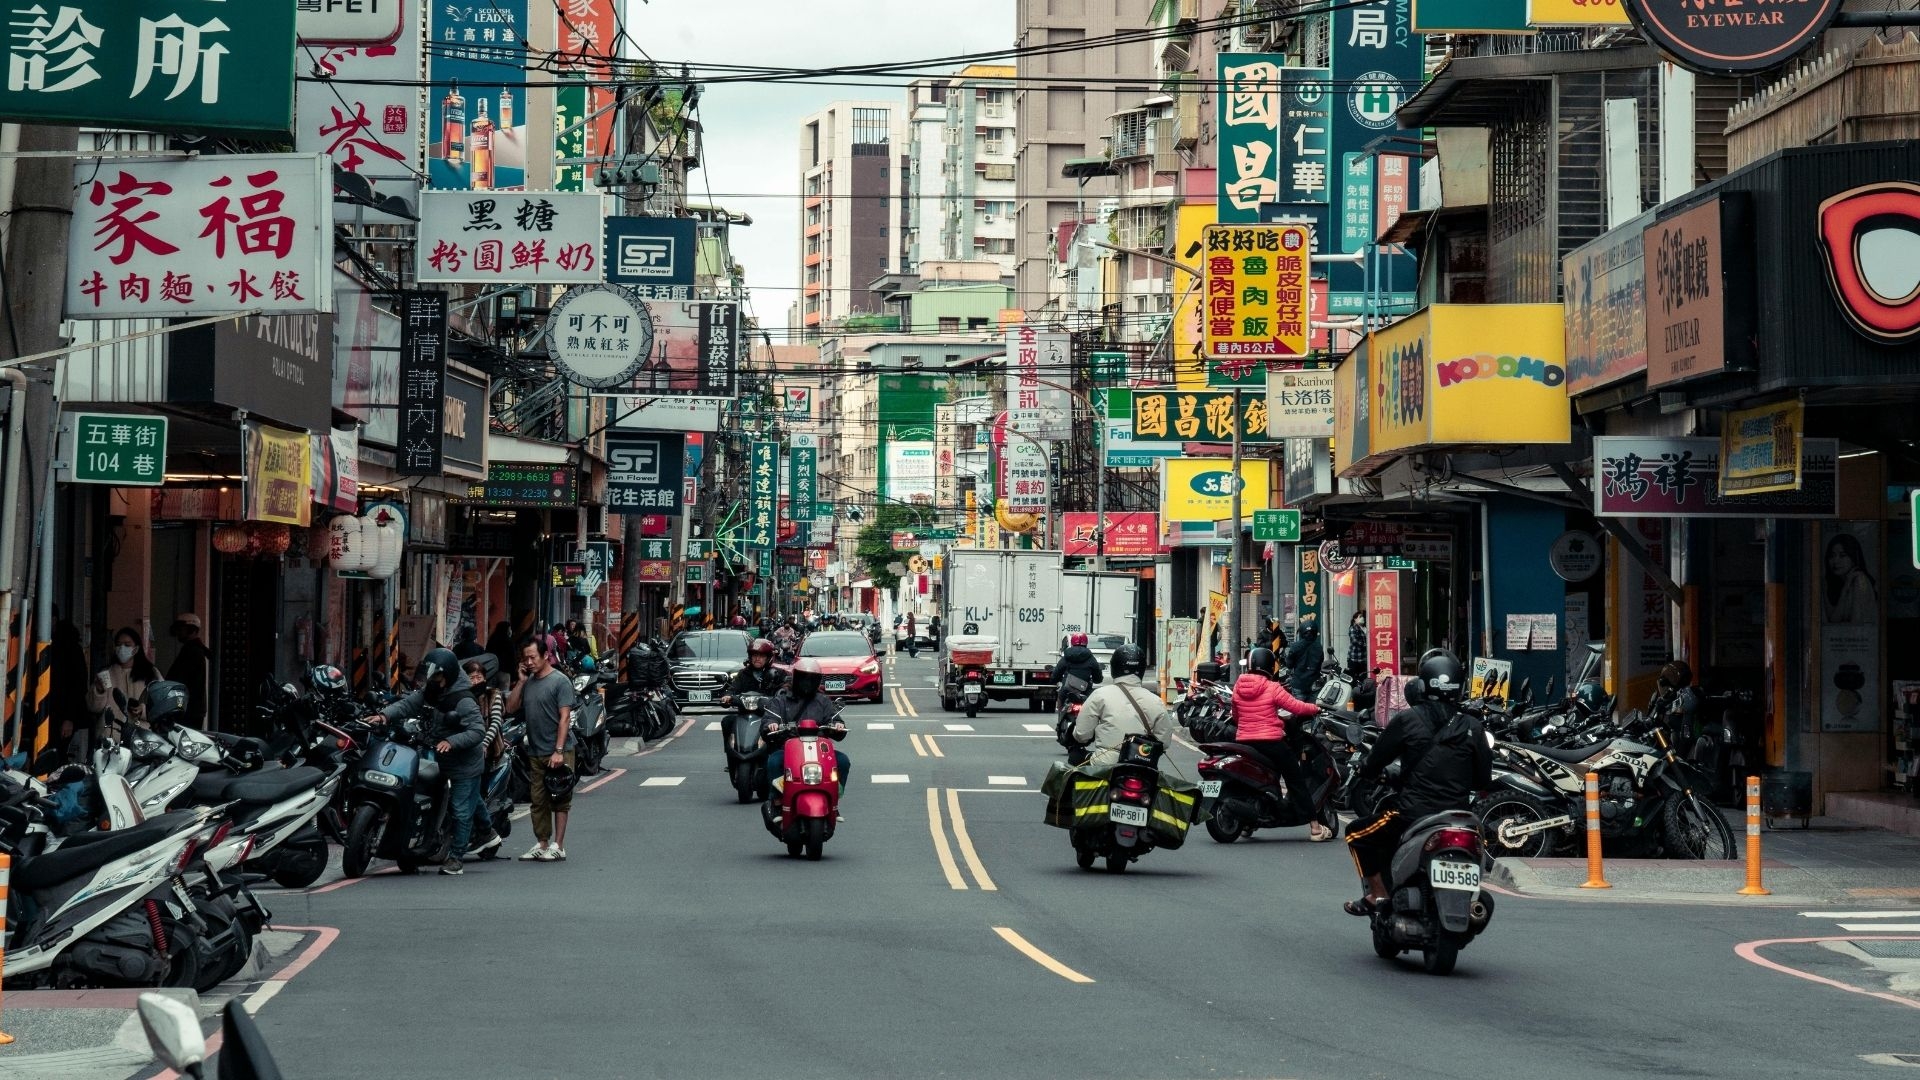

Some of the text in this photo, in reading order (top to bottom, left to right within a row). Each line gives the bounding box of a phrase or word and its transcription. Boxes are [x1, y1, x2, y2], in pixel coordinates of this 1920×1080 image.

[475, 14, 514, 23] LEADER
[1687, 12, 1784, 28] EYEWEAR
[445, 27, 514, 41] 仕高利達
[9, 4, 230, 103] 診所
[1225, 62, 1278, 212] 國昌
[90, 170, 295, 265] 家福
[463, 199, 558, 232] 黑糖
[1346, 185, 1357, 237] 免費領藥
[1358, 185, 1369, 237] 慢性處方
[1208, 230, 1279, 252] 好好吃
[428, 239, 595, 273] 粉圓鮮奶
[621, 267, 671, 275] Sun Flower
[1209, 256, 1235, 337] 魯肉便當
[1242, 256, 1268, 337] 魯肉飯
[1276, 256, 1303, 337] 脆皮蚵仔煎
[568, 313, 631, 334] 可不可
[567, 336, 630, 352] 熟成紅茶
[708, 304, 730, 387] 仟恩菸酒
[1217, 342, 1276, 354] 巷內5公尺
[1665, 319, 1700, 354] EYEWEAR
[407, 297, 440, 468] 詳情請內洽
[1436, 355, 1565, 387] KODOMO
[86, 423, 157, 446] 五華街
[89, 453, 155, 476] 104 巷
[1016, 480, 1045, 495] 續約
[1603, 451, 1697, 504] 鴻祥
[487, 488, 512, 497] 13:30
[522, 489, 548, 498] 22:30
[1257, 514, 1289, 525] 五華街
[1261, 526, 1288, 537] 71 巷
[648, 542, 702, 558] 檳城
[1028, 563, 1037, 599] 新竹物流
[1019, 607, 1045, 622] 6295
[1112, 807, 1145, 822] NRP-5811
[1433, 868, 1479, 887] LU9-589
